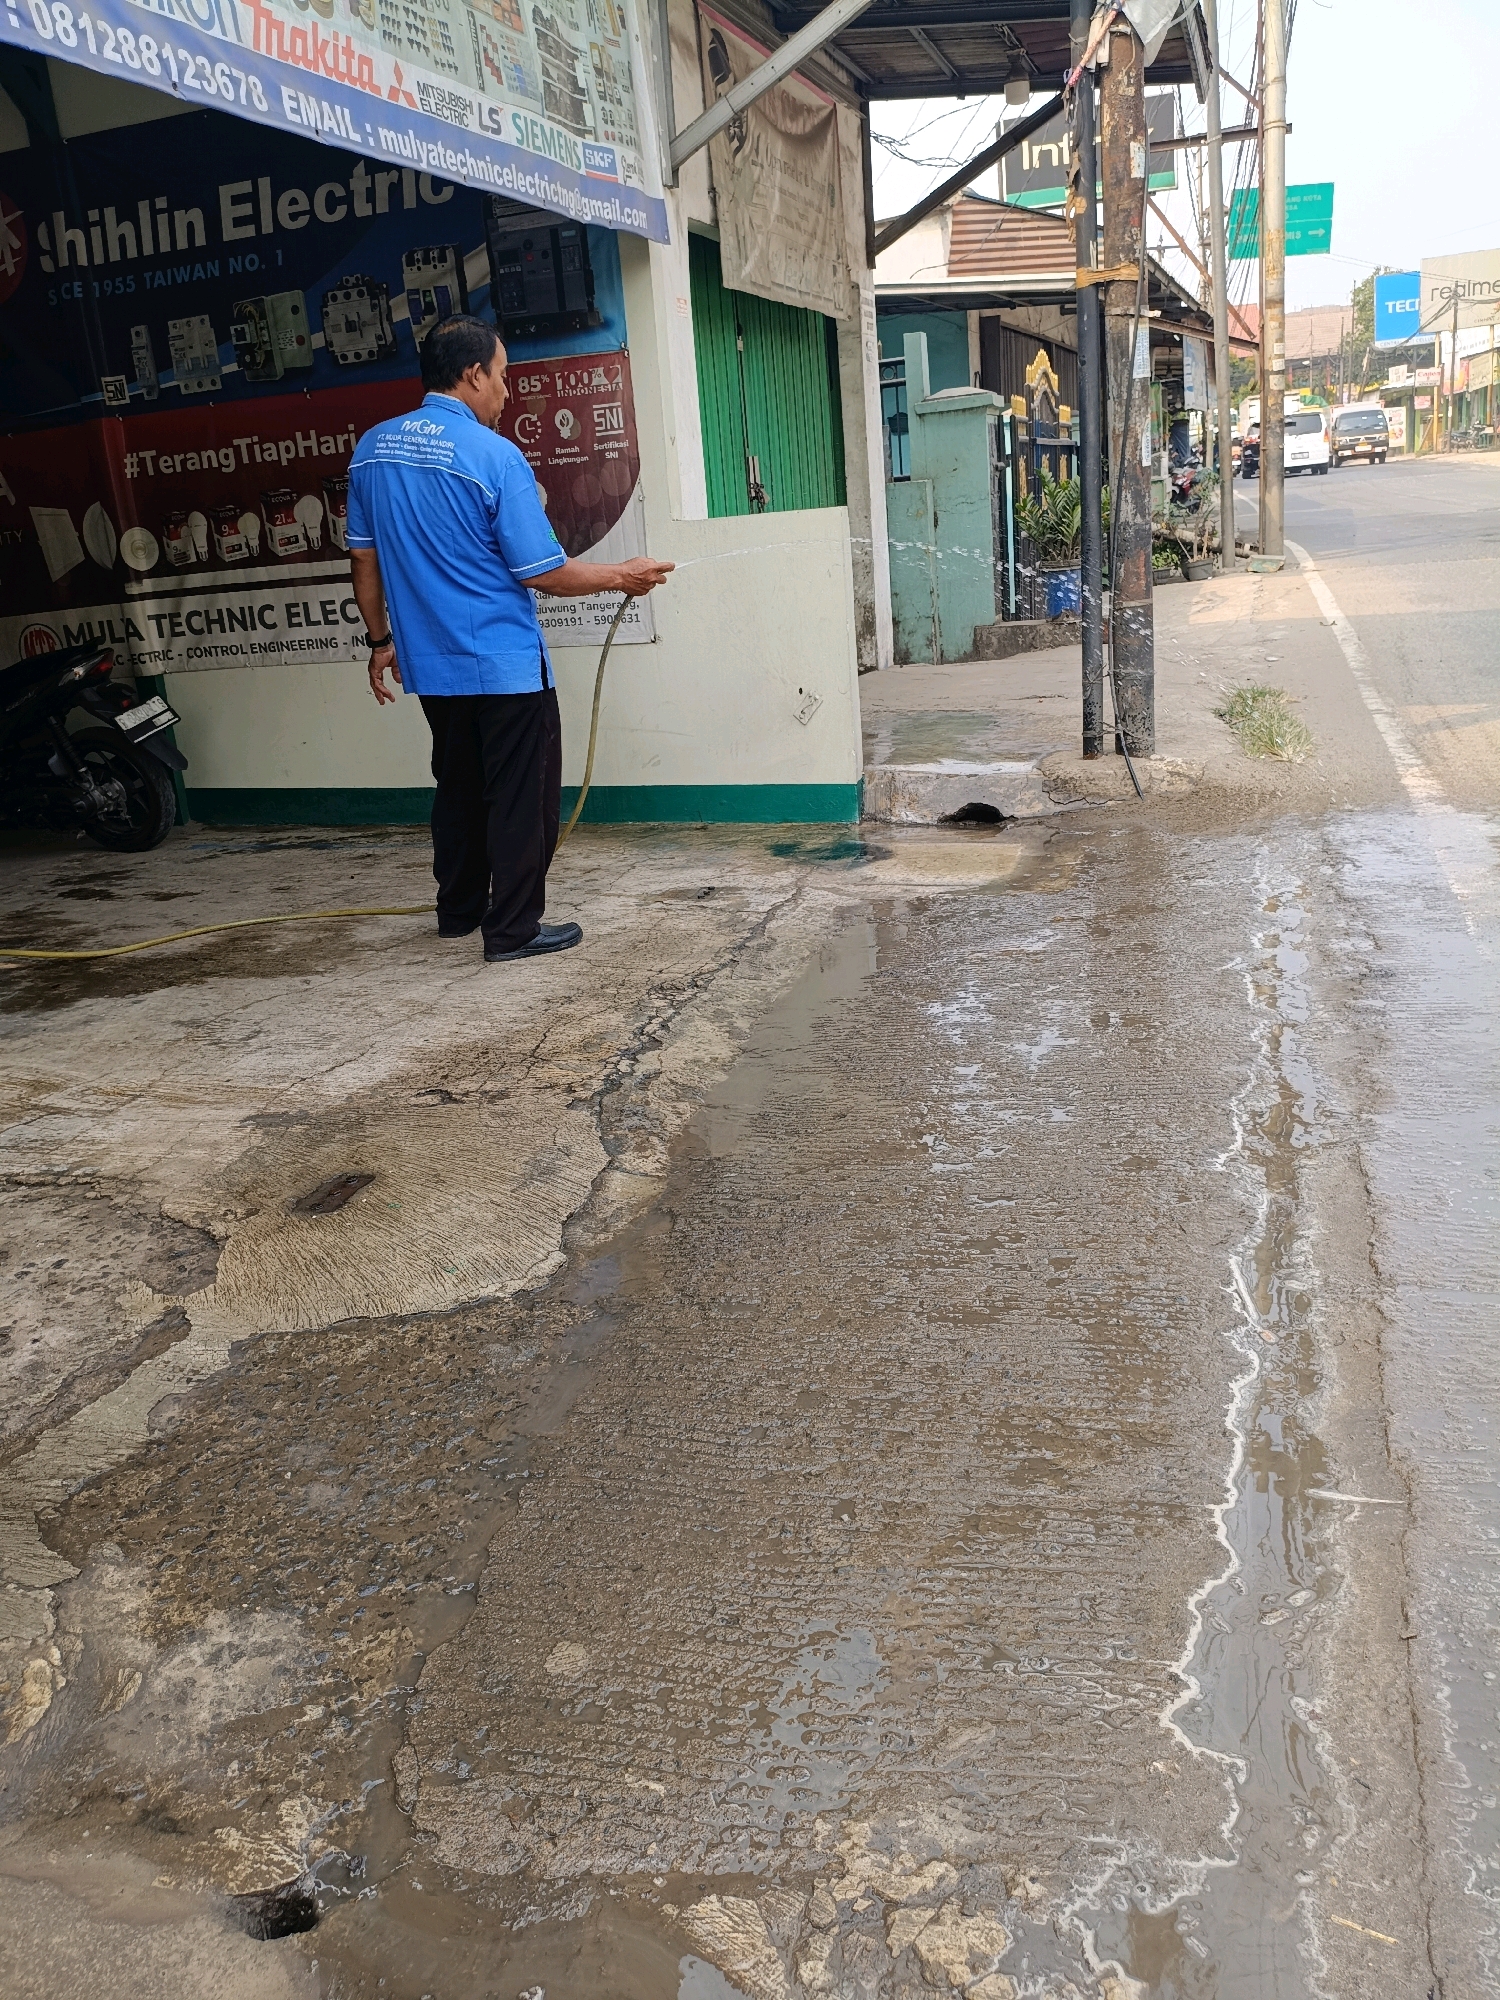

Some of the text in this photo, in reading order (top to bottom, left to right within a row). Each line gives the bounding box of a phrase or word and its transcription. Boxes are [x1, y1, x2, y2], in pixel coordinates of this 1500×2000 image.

[240, 0, 383, 97] makita
[416, 80, 475, 116] MITSUBISHI
[27, 0, 268, 112] 081288123678
[280, 85, 362, 143] EMAIL
[377, 126, 648, 230] mulyatechnicelectrictng@gmail.com
[421, 98, 470, 129] ELECTRIC
[478, 102, 503, 136] LS
[511, 112, 582, 171] SIEMENS
[585, 149, 614, 168] SKF
[218, 159, 455, 242] Electric
[92, 275, 136, 299] 1955
[143, 259, 220, 290] TAIWAN
[229, 253, 266, 274] NO.
[276, 249, 283, 266] 1
[105, 381, 127, 400] SNI
[518, 374, 550, 393] 85%
[400, 419, 446, 436] MGM
[593, 407, 625, 431] SNI
[403, 435, 429, 445] GENERAL
[555, 446, 580, 455] Ramah
[593, 440, 630, 451] Sertifikasi
[124, 424, 357, 479] #TerangTiapHari
[522, 450, 542, 458] ahan
[548, 455, 590, 466] Lingkungan
[605, 451, 619, 459] SNI
[578, 600, 640, 612] Tangerag,
[147, 603, 278, 639] TECHNIC
[594, 613, 641, 626] 590631
[186, 643, 248, 660] CONTROL
[250, 636, 339, 655] ENGINEERING
